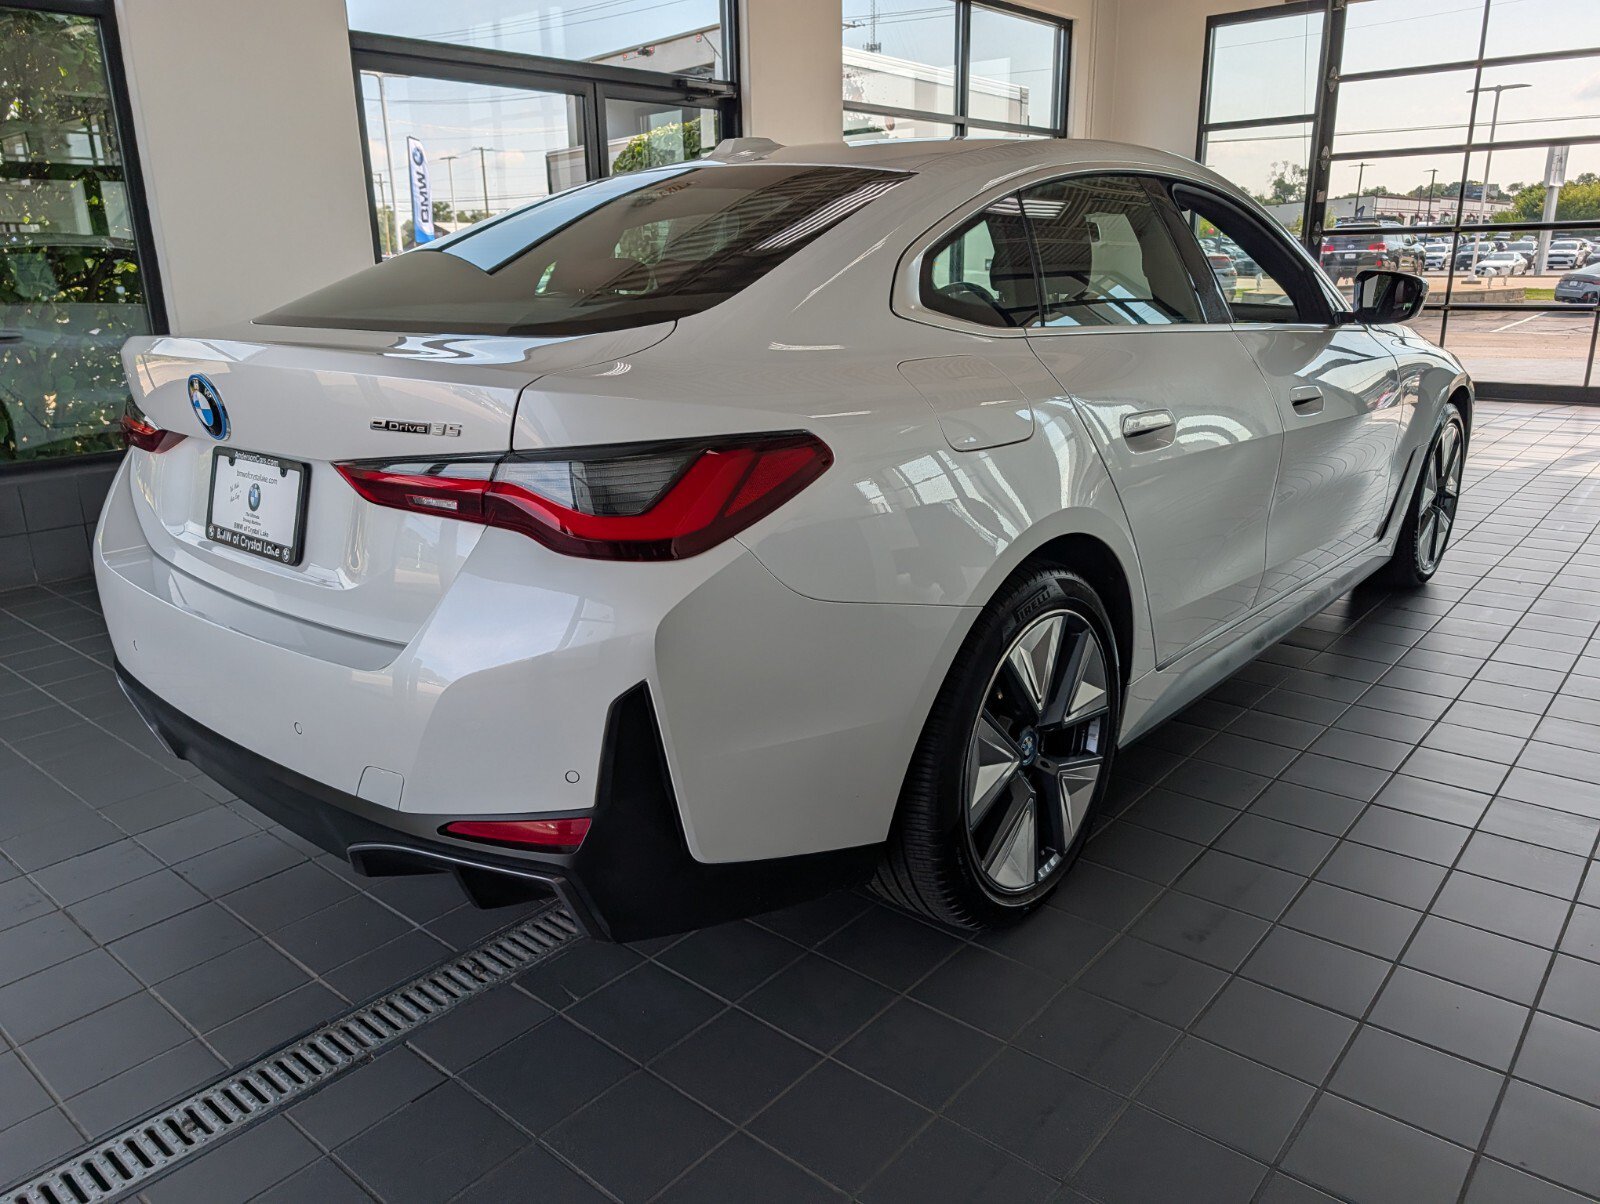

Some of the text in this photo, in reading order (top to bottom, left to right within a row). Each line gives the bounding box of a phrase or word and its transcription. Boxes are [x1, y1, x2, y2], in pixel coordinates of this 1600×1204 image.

[416, 171, 429, 223] BMW
[216, 528, 232, 542] BMW
[232, 534, 240, 545] of
[240, 536, 262, 552] Crystal
